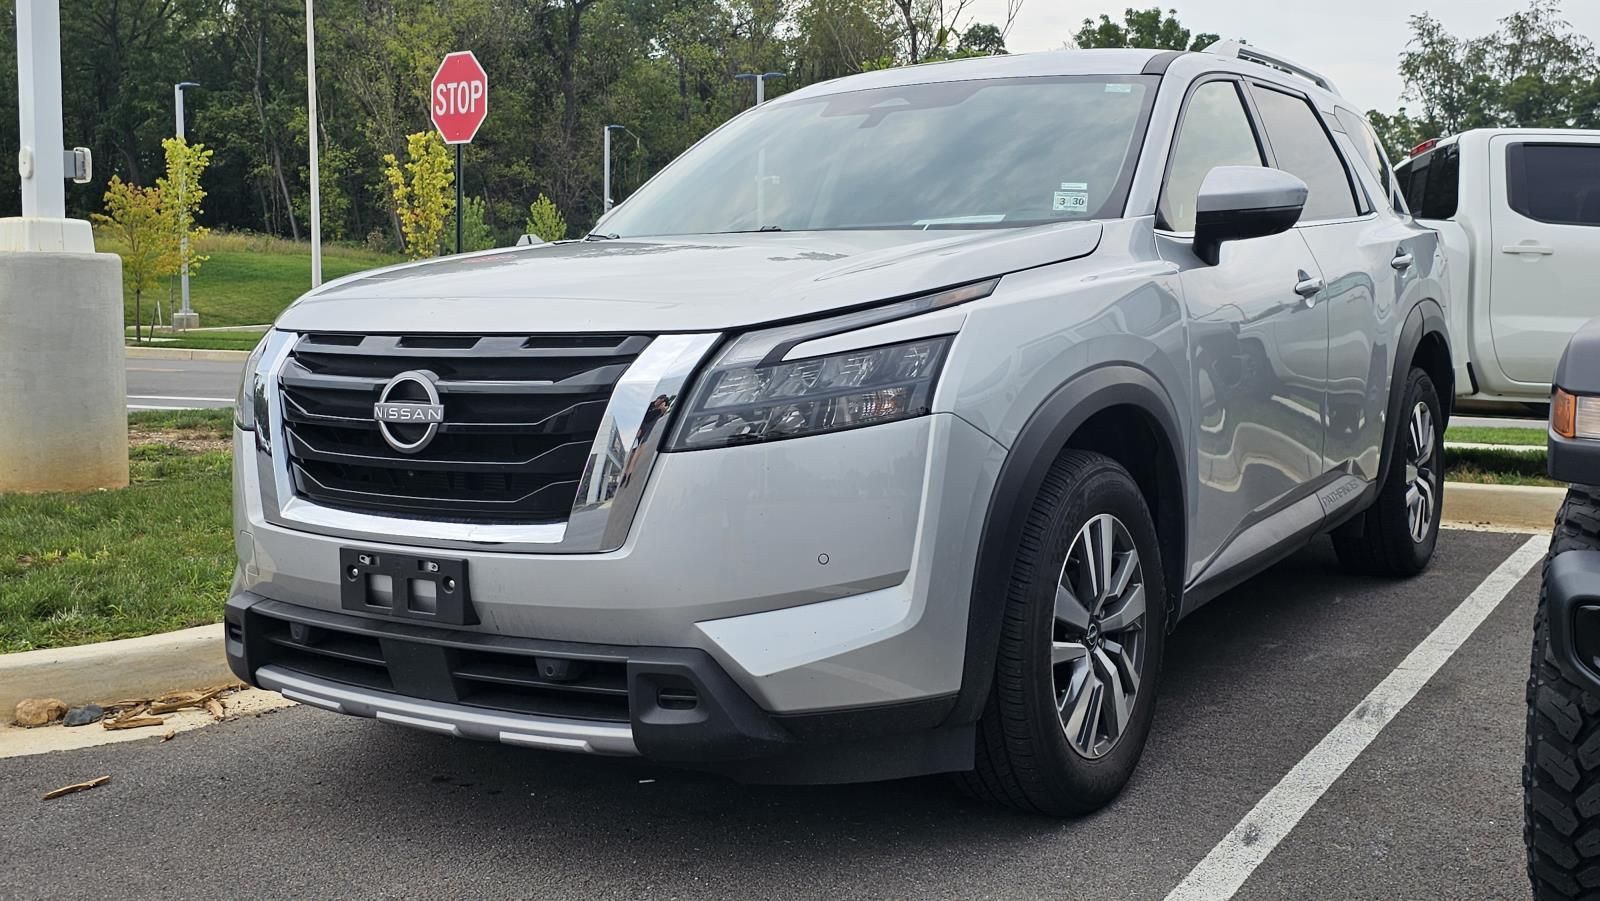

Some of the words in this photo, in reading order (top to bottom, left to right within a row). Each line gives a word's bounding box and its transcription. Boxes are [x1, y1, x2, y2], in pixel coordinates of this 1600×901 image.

[435, 80, 483, 116] STOP
[1059, 197, 1066, 206] 3
[1072, 197, 1085, 206] 30
[375, 406, 441, 420] NISSAN
